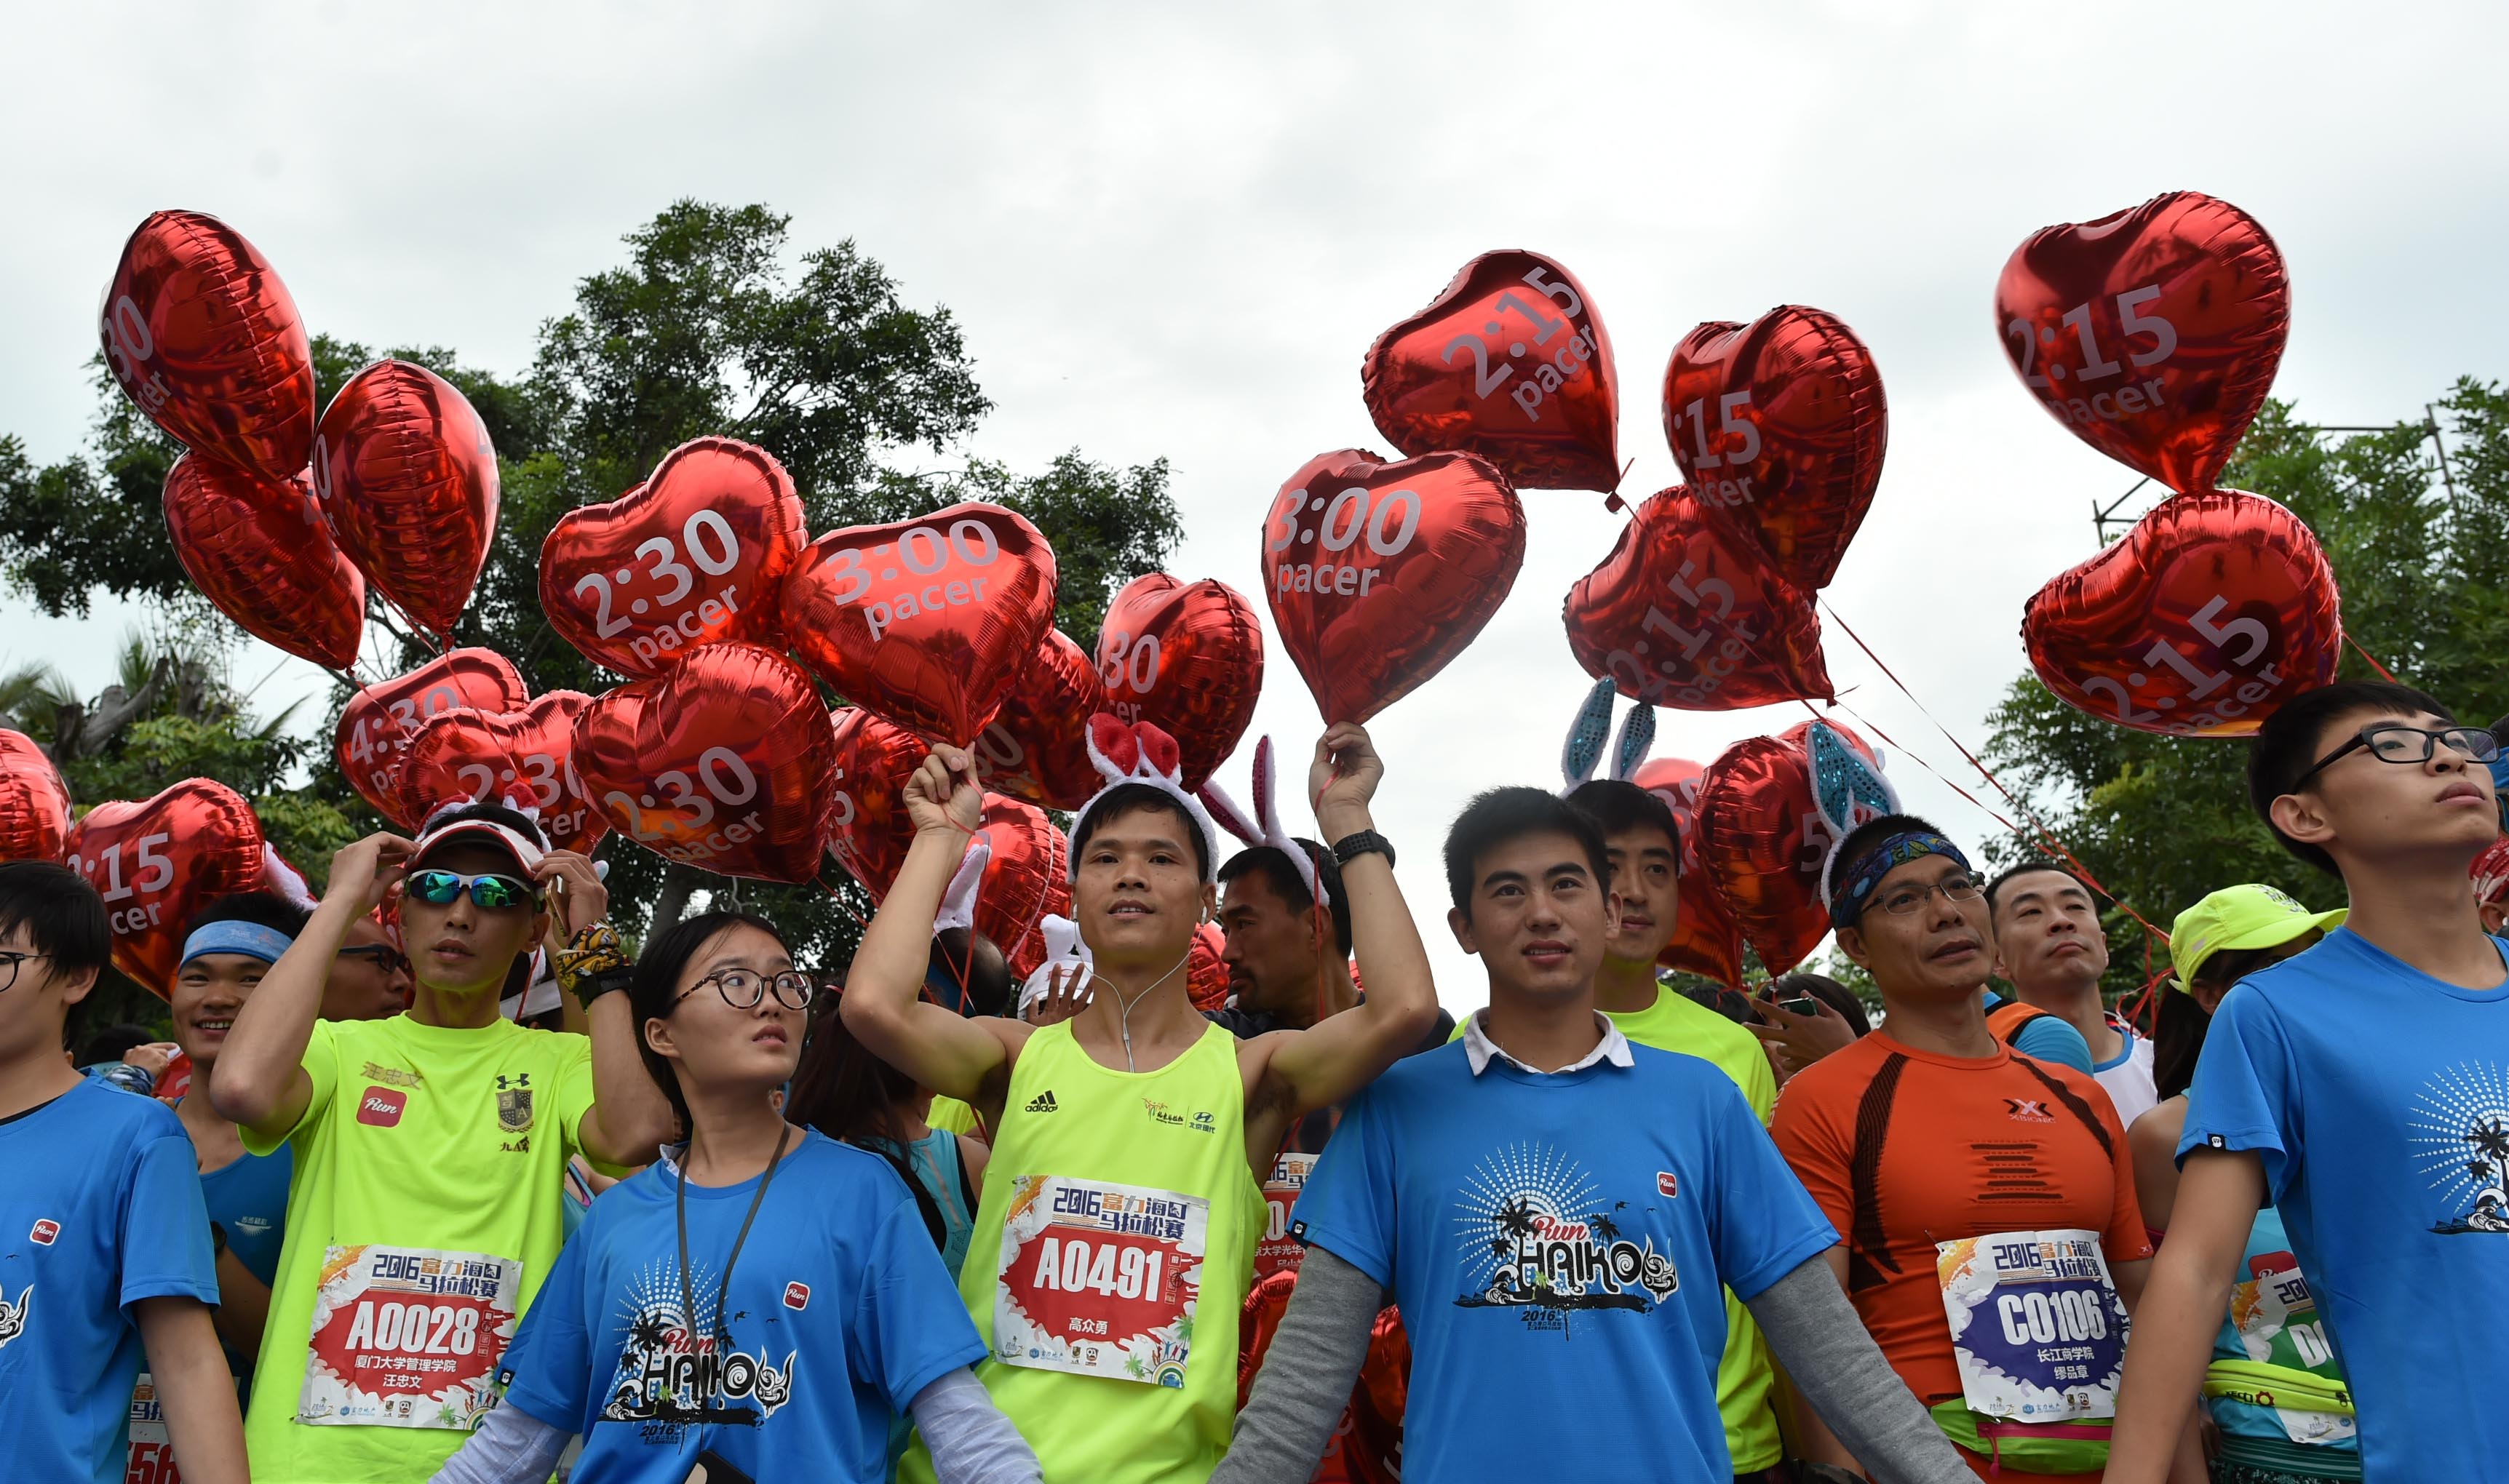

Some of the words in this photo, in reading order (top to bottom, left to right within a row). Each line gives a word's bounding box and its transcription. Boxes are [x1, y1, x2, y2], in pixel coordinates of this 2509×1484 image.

[1441, 266, 1583, 400] 2:15
[2008, 284, 2178, 388] 2:15
[1510, 322, 1599, 423] pacer
[1271, 487, 1421, 556] 3:00
[574, 510, 739, 640] 2:30
[827, 519, 999, 606] 3:00
[1277, 558, 1380, 603] pacer
[629, 583, 742, 669] pacer
[864, 573, 989, 642] pacer
[1606, 559, 1735, 696] 2:15
[1677, 619, 1757, 706] pacer
[2080, 594, 2269, 725] 2:15
[604, 746, 758, 842] 2:30
[665, 807, 766, 864] pacer
[365, 1097, 398, 1114] Run
[1025, 1104, 1058, 1112] adidas
[1660, 1178, 1675, 1189] Run
[35, 1224, 55, 1237] Run
[1099, 1210, 1185, 1240] 马拉松赛
[1530, 1216, 1588, 1241] Run
[417, 1274, 501, 1298] 马拉松赛
[1033, 1237, 1164, 1302] A0491
[787, 1288, 806, 1301] Run
[1520, 1310, 1556, 1321] 2016
[1997, 1290, 2107, 1345] C0106
[345, 1301, 480, 1355] A0028
[1068, 1317, 1108, 1336] 高众勇
[354, 1355, 458, 1373] 厦门大学管理学院
[2037, 1346, 2095, 1363] 长江商学院
[2053, 1365, 2089, 1381] 缪品章
[383, 1374, 423, 1389] 汪忠文
[640, 1425, 676, 1437] 2016
